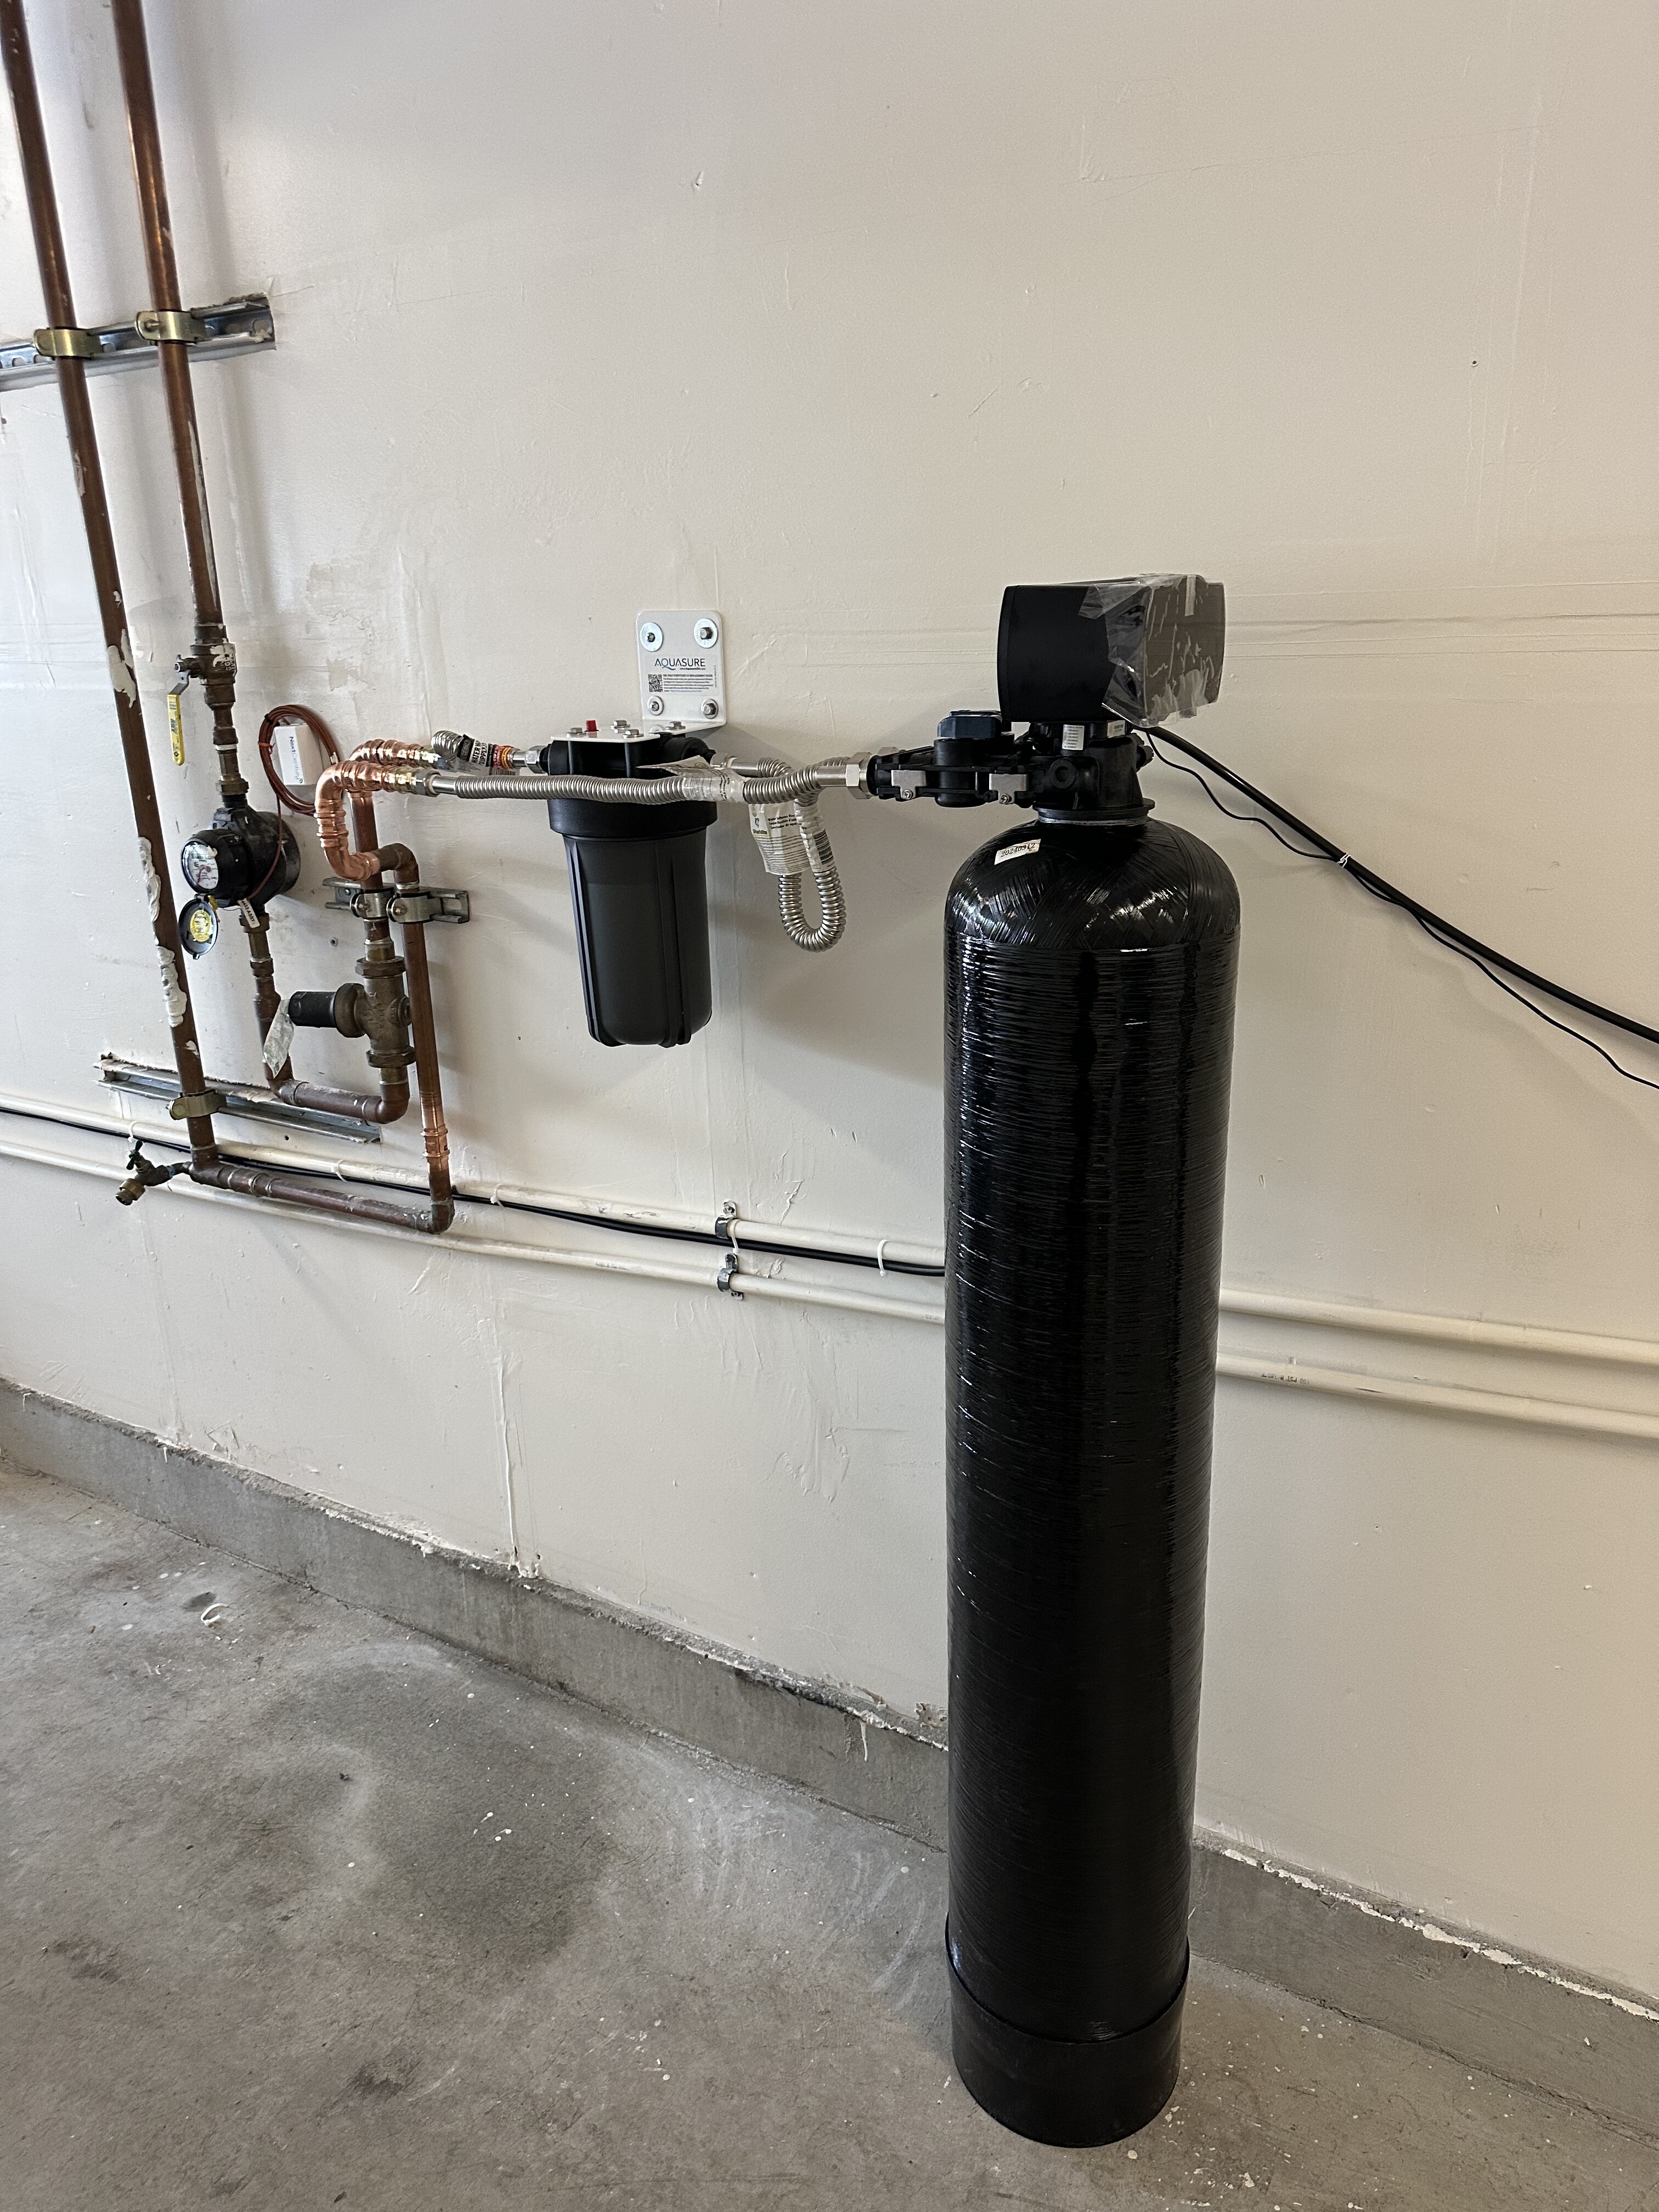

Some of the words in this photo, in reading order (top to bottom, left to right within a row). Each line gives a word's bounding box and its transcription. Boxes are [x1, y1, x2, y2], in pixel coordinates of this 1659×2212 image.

[654, 658, 706, 670] AQUASURE
[471, 747, 481, 764] WATER
[478, 746, 488, 765] SUPPLY
[1000, 842, 1036, 857] 20240912
